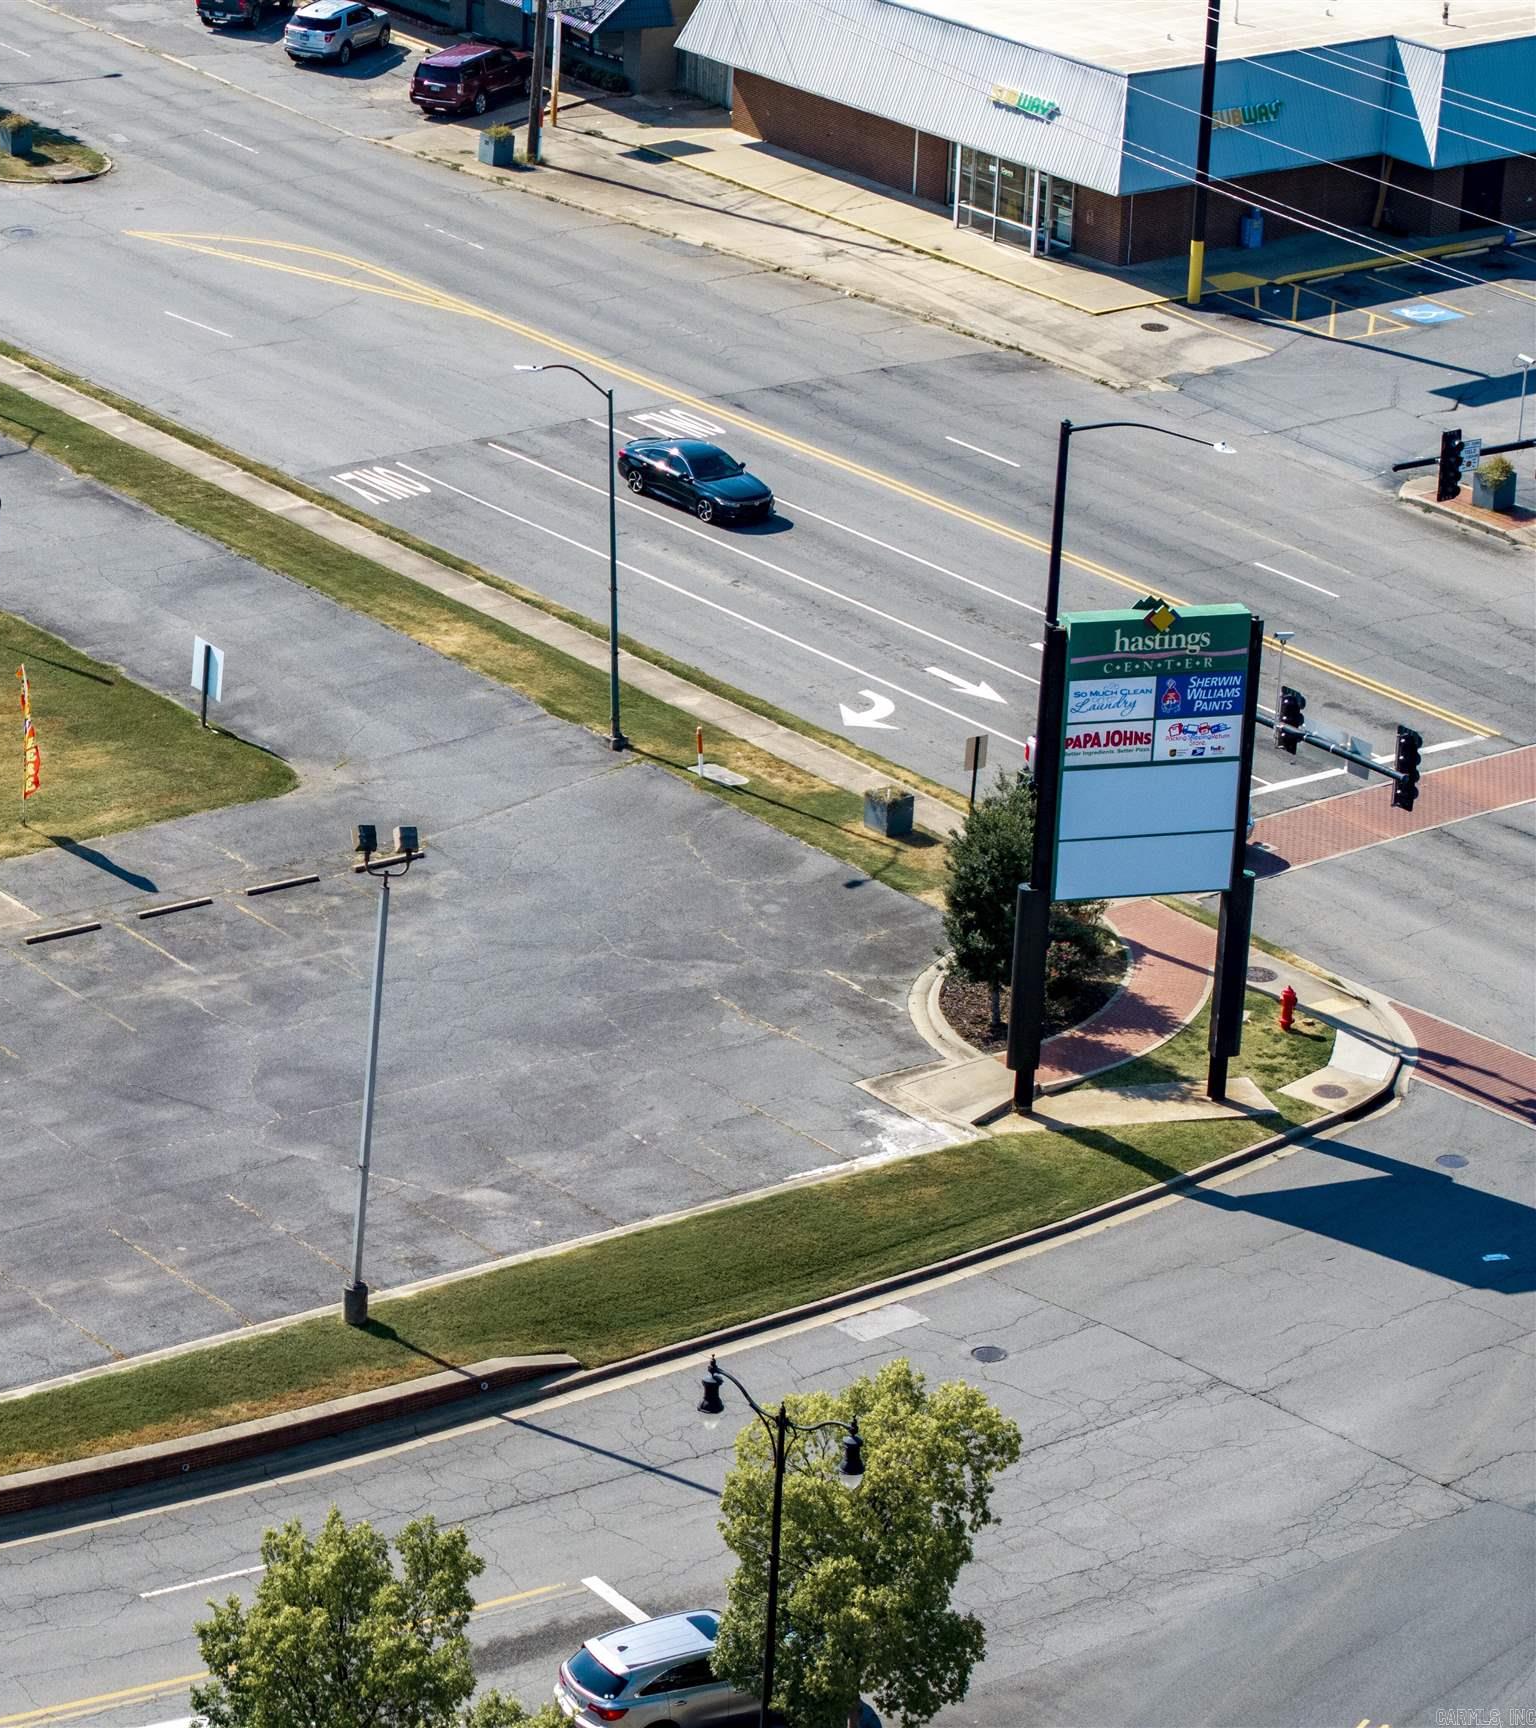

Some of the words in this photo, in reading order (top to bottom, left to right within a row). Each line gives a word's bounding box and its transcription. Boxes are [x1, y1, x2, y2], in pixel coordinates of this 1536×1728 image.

[329, 466, 431, 504] ONLY
[1113, 628, 1211, 655] hastings
[1188, 675, 1242, 688] SHERWIN
[1187, 688, 1241, 700] WILLIAMS
[1070, 695, 1137, 717] Laundry
[1193, 700, 1233, 712] PAINTS
[1064, 732, 1102, 749] PAPA
[1103, 730, 1152, 748] JOHNS
